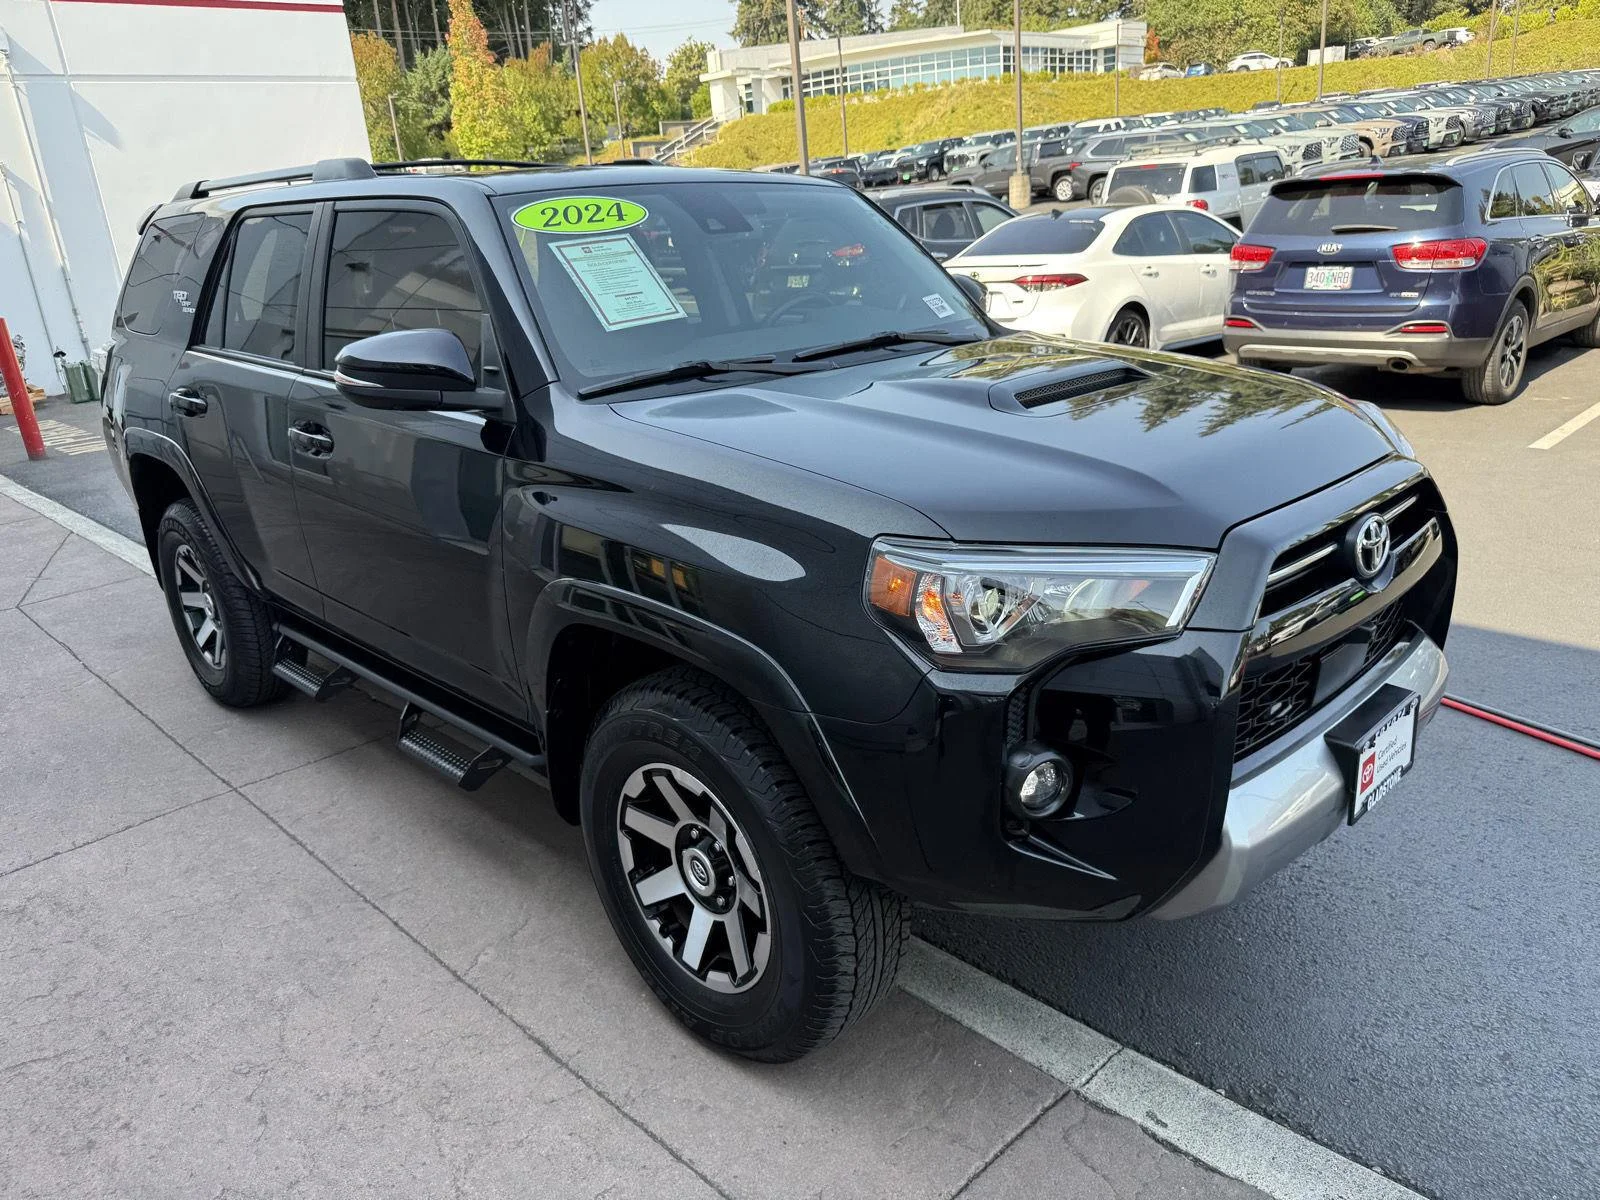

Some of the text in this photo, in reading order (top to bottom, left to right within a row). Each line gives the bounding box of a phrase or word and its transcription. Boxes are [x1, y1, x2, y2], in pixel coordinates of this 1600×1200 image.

[540, 202, 628, 228] 2024
[1321, 243, 1338, 252] KIA
[1308, 271, 1326, 284] 340
[1378, 736, 1398, 760] Certified
[1387, 743, 1407, 762] Vehicles
[1367, 767, 1402, 811] GLADSTONE
